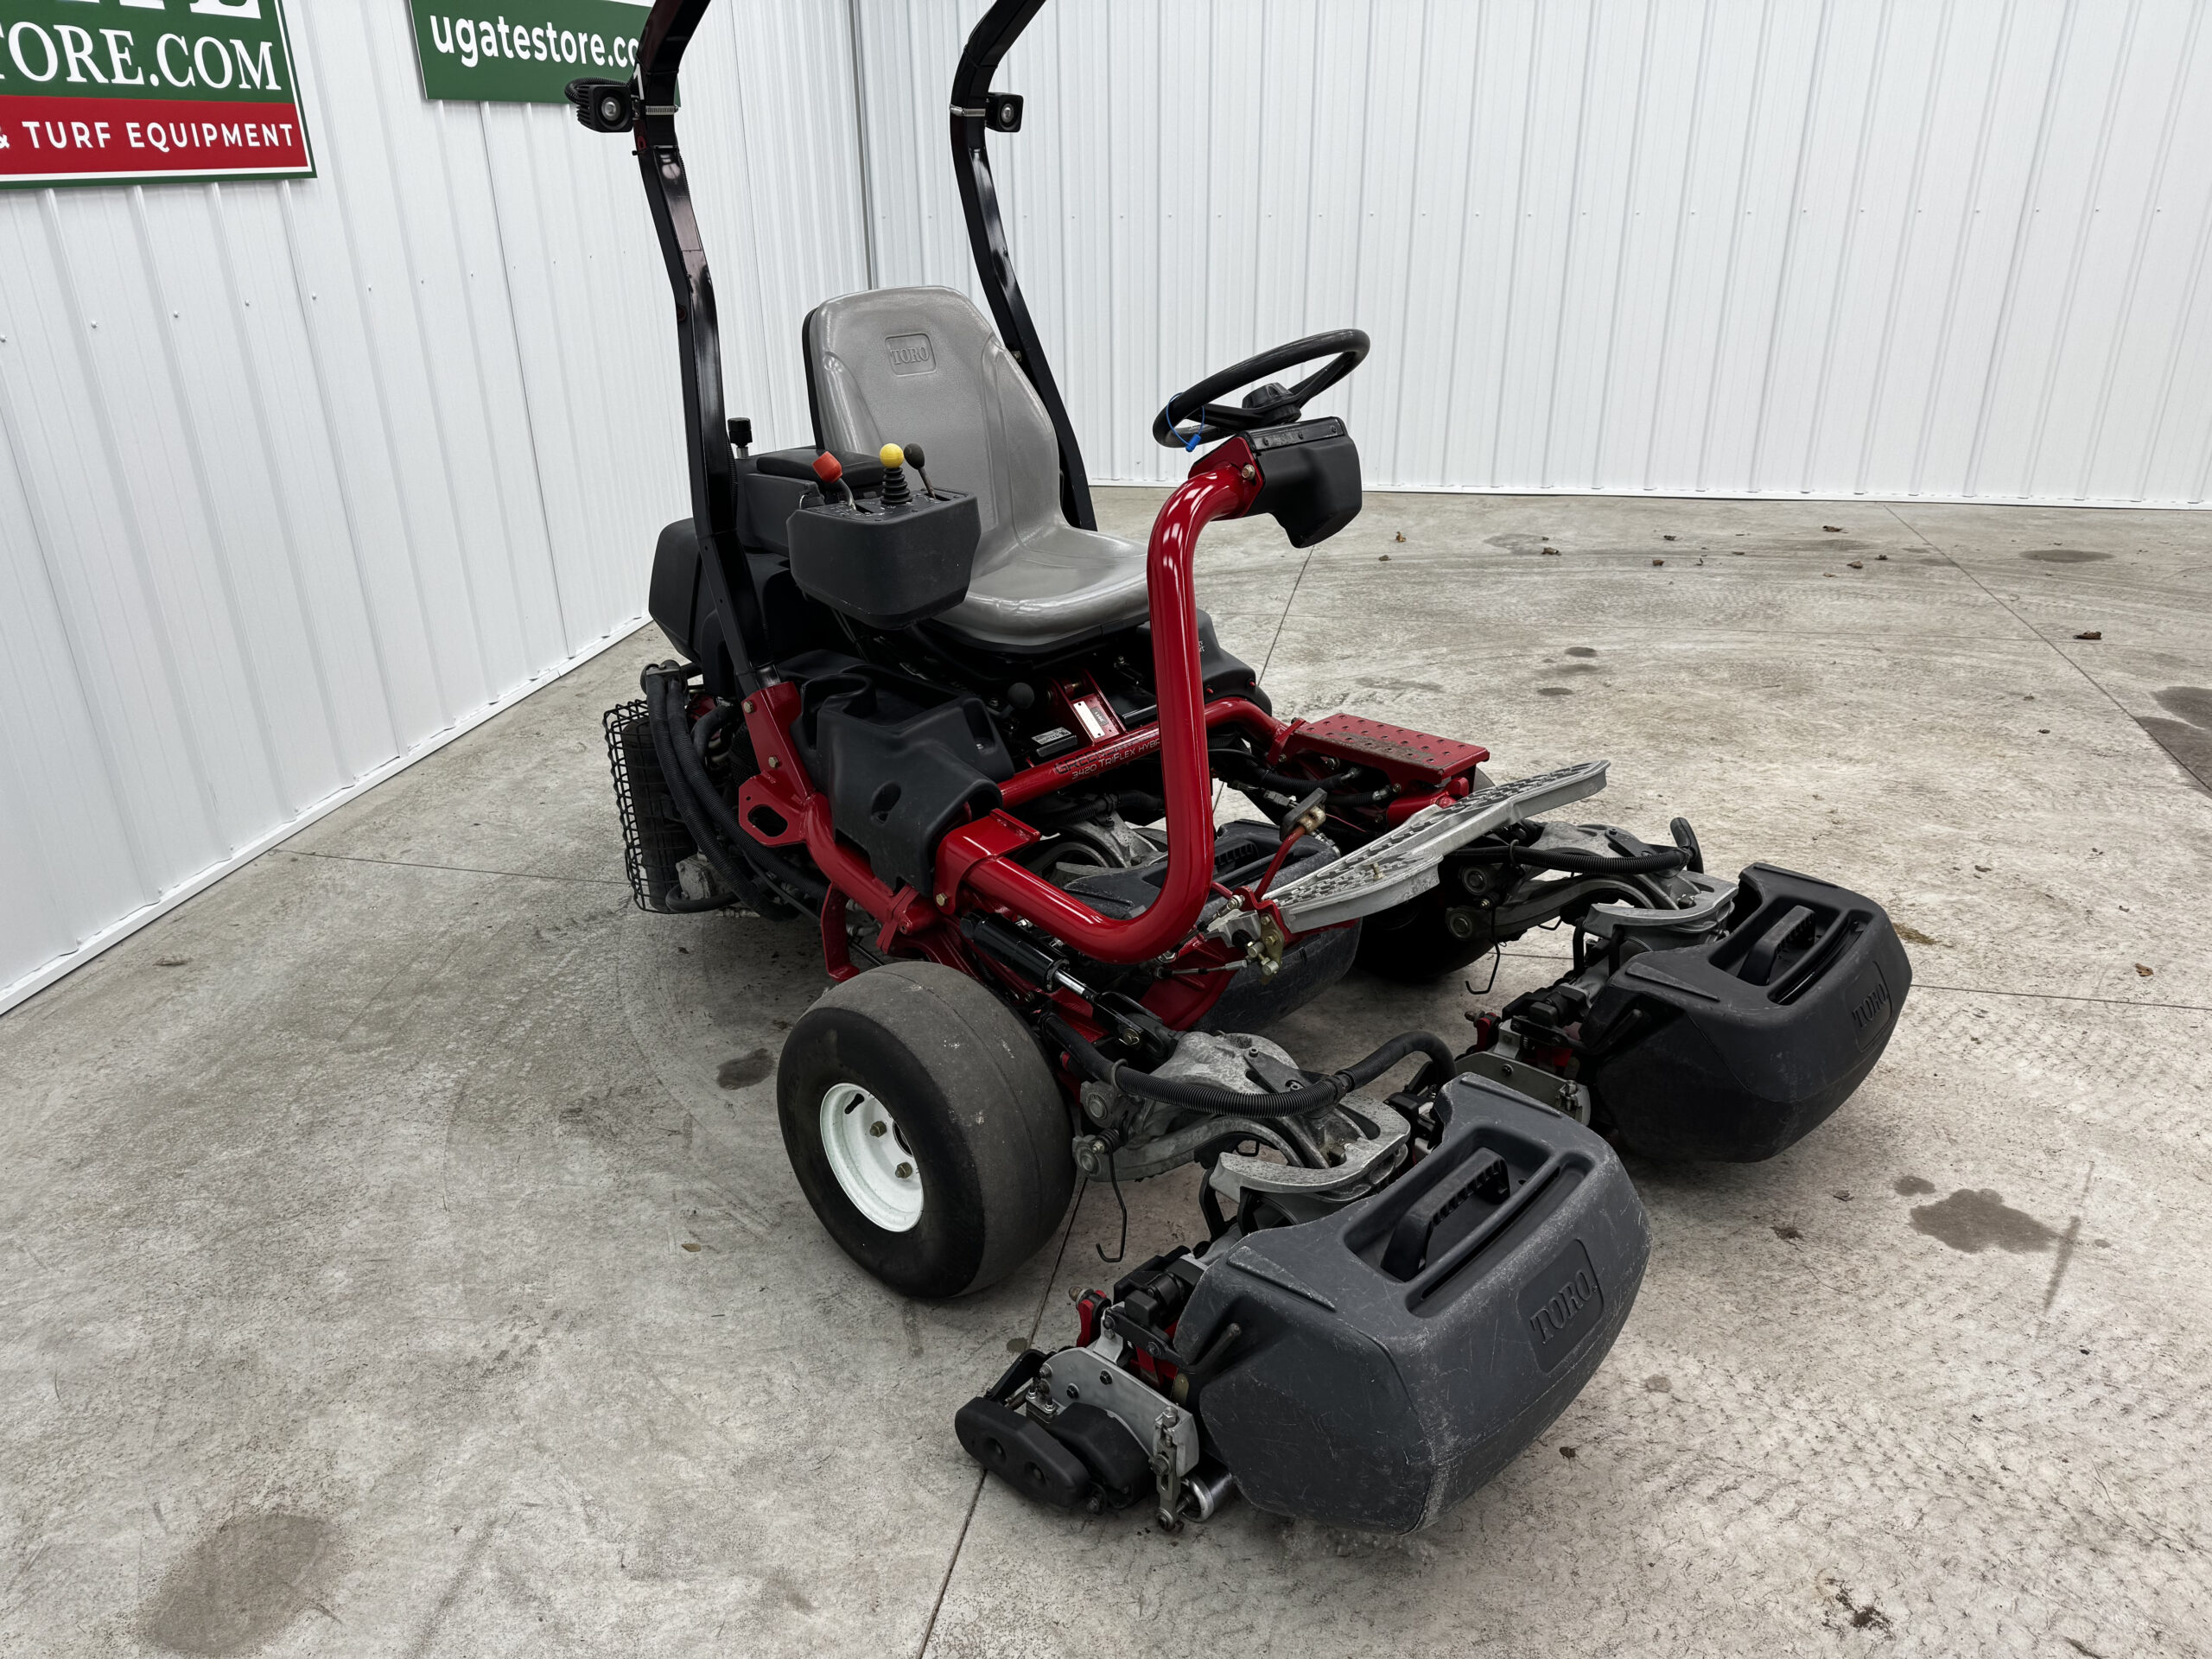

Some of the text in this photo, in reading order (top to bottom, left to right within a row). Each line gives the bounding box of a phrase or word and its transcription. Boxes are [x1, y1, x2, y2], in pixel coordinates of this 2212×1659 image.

[0, 21, 282, 90] ORE.COM
[429, 15, 639, 68] ugatestore.co
[22, 121, 111, 149] TURF
[126, 122, 293, 153] EQUIPMENT
[890, 346, 930, 365] TORO
[1071, 764, 1097, 779] 3420
[1852, 983, 1889, 1029] TORO
[1530, 1269, 1592, 1344] TORO
